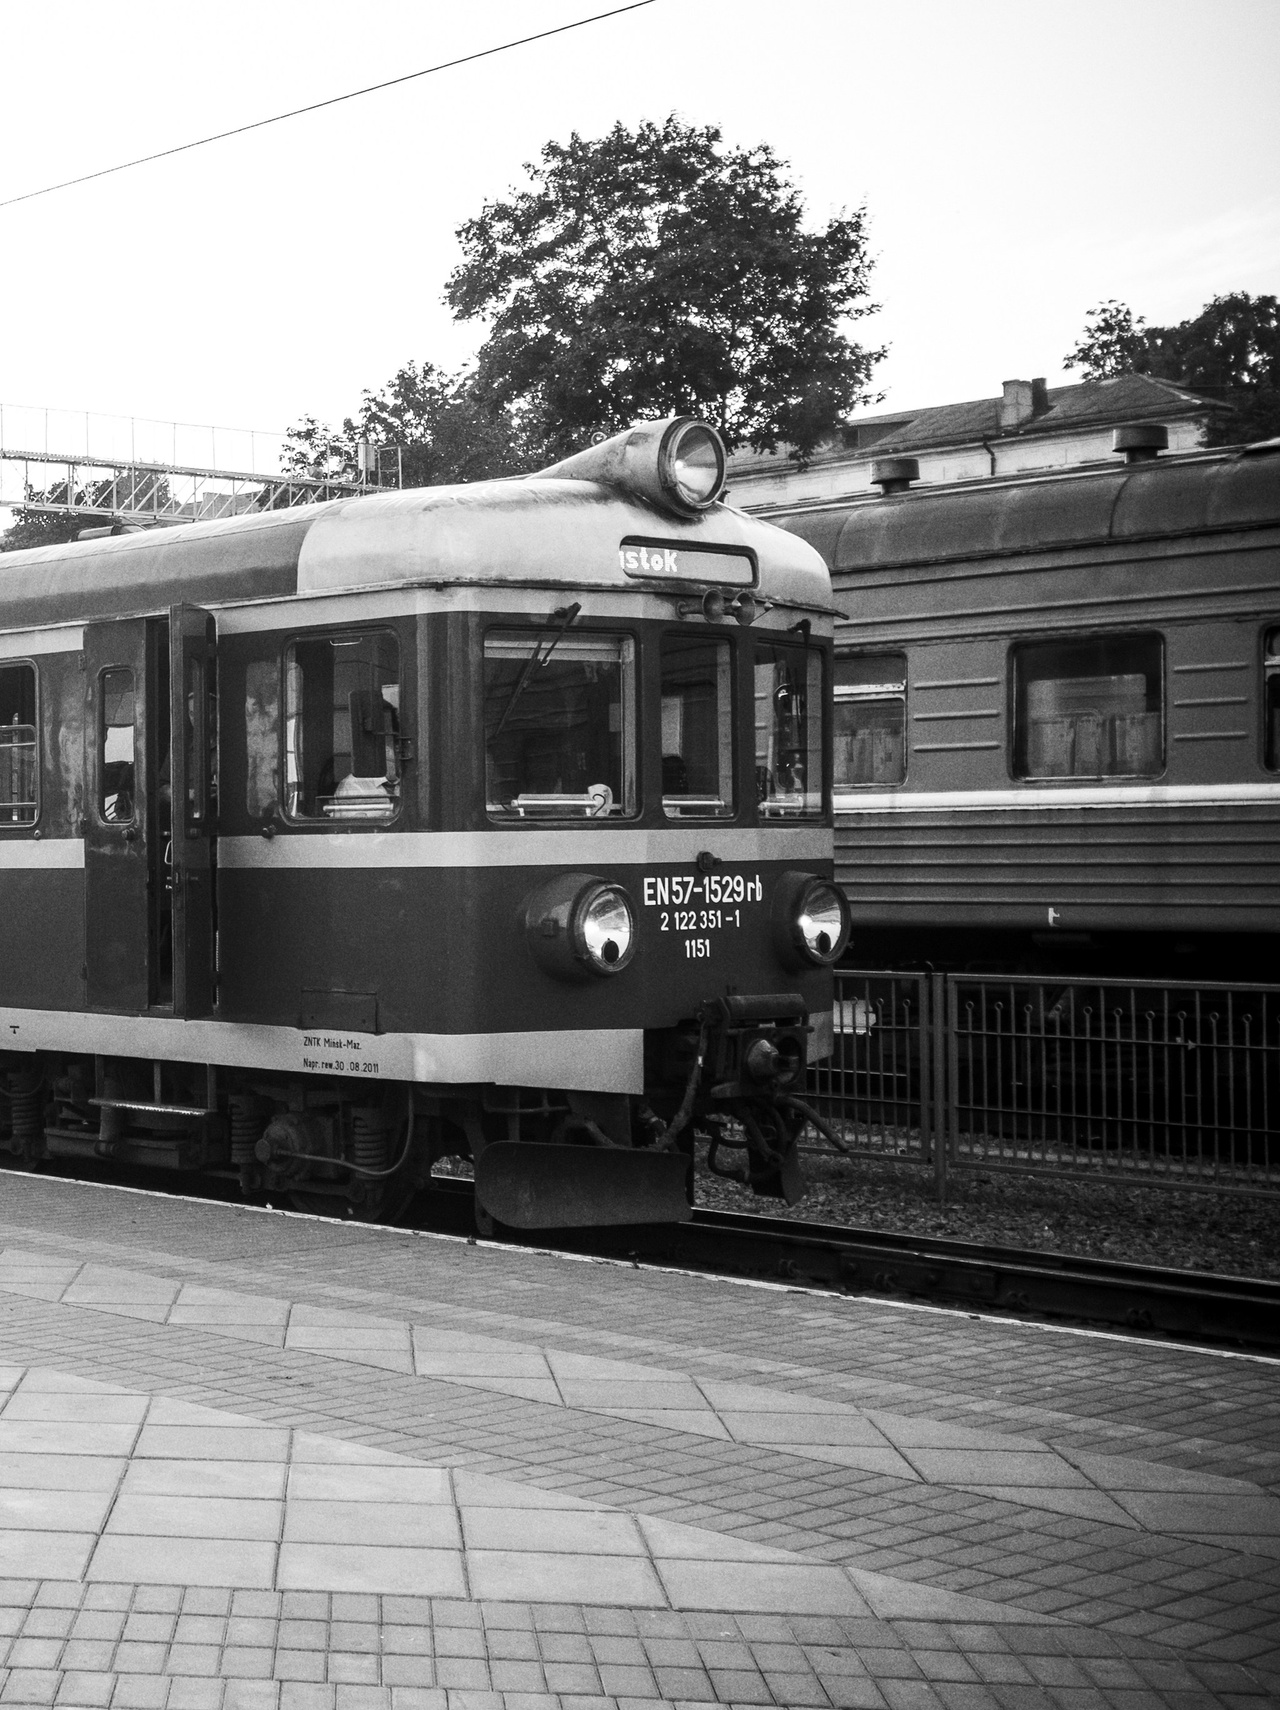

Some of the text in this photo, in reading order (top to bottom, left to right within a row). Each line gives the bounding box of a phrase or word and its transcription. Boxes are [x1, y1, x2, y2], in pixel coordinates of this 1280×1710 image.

[660, 912, 669, 931] 2
[674, 911, 697, 931] 122
[700, 910, 722, 930] 351
[685, 939, 710, 958] 1151
[303, 1036, 321, 1048] ZNTK
[303, 1057, 321, 1070] Napr.
